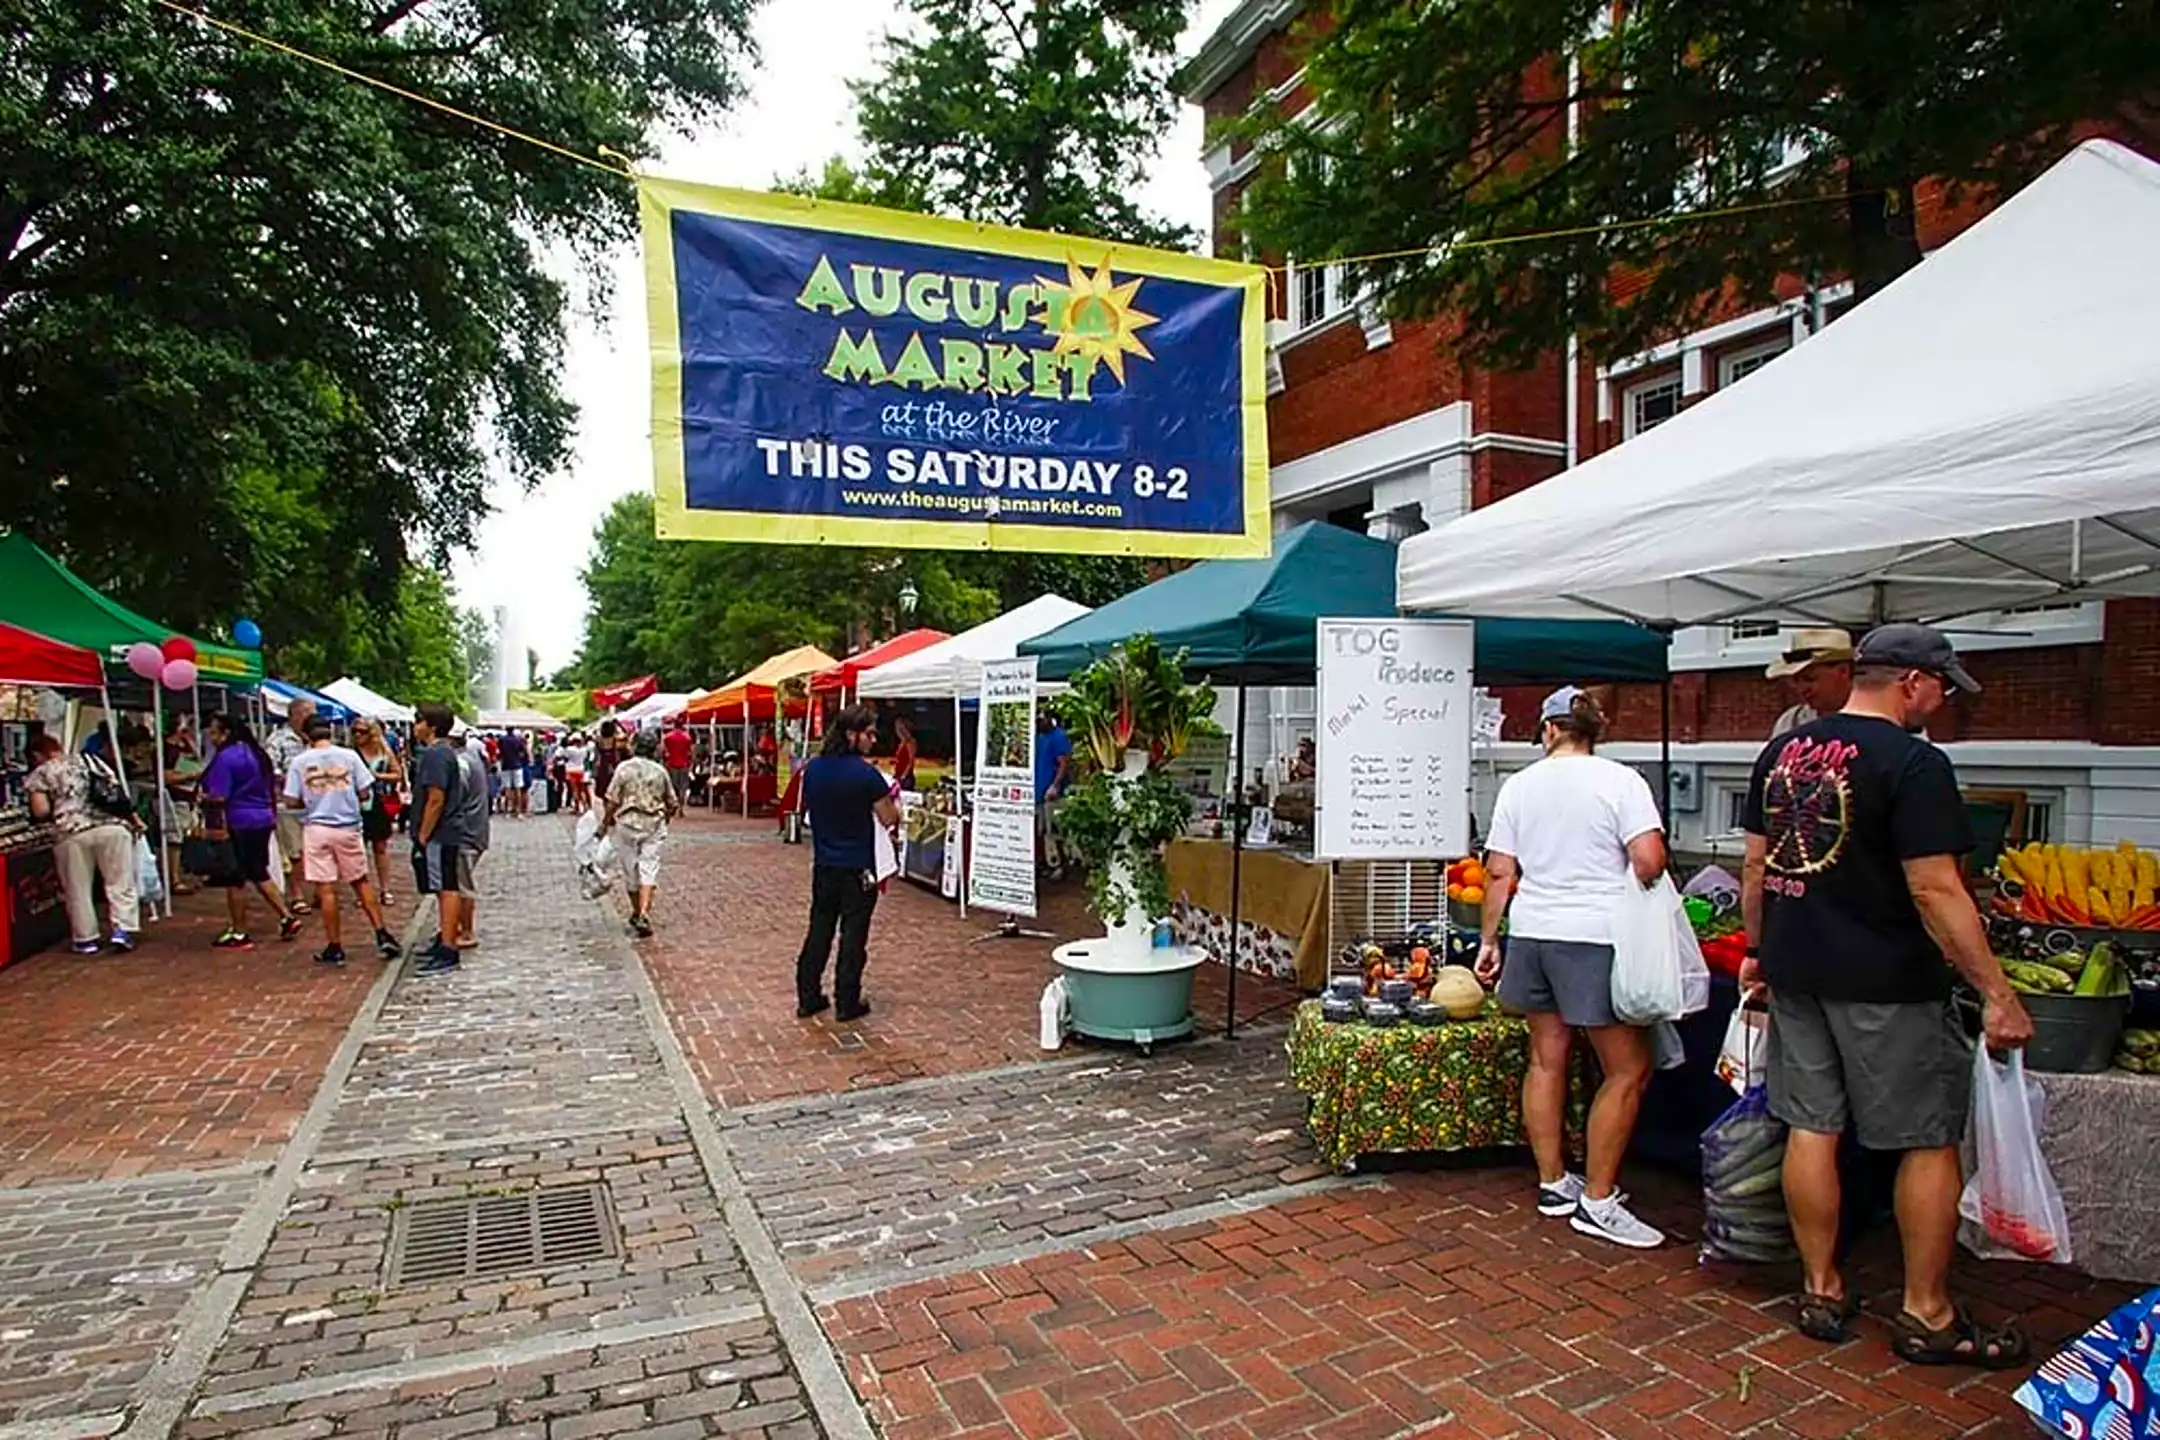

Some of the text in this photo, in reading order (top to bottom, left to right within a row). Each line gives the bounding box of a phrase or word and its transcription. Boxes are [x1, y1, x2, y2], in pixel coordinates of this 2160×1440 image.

[796, 254, 1115, 337] AUGUSTA
[823, 327, 1097, 402] MARKET
[881, 400, 1060, 435] at the River
[757, 438, 1189, 500] THIS SATURDAY 8-2
[842, 489, 1122, 518] www.theaugusamarket.com
[1327, 627, 1400, 654] TOG
[1378, 656, 1456, 684] Produce
